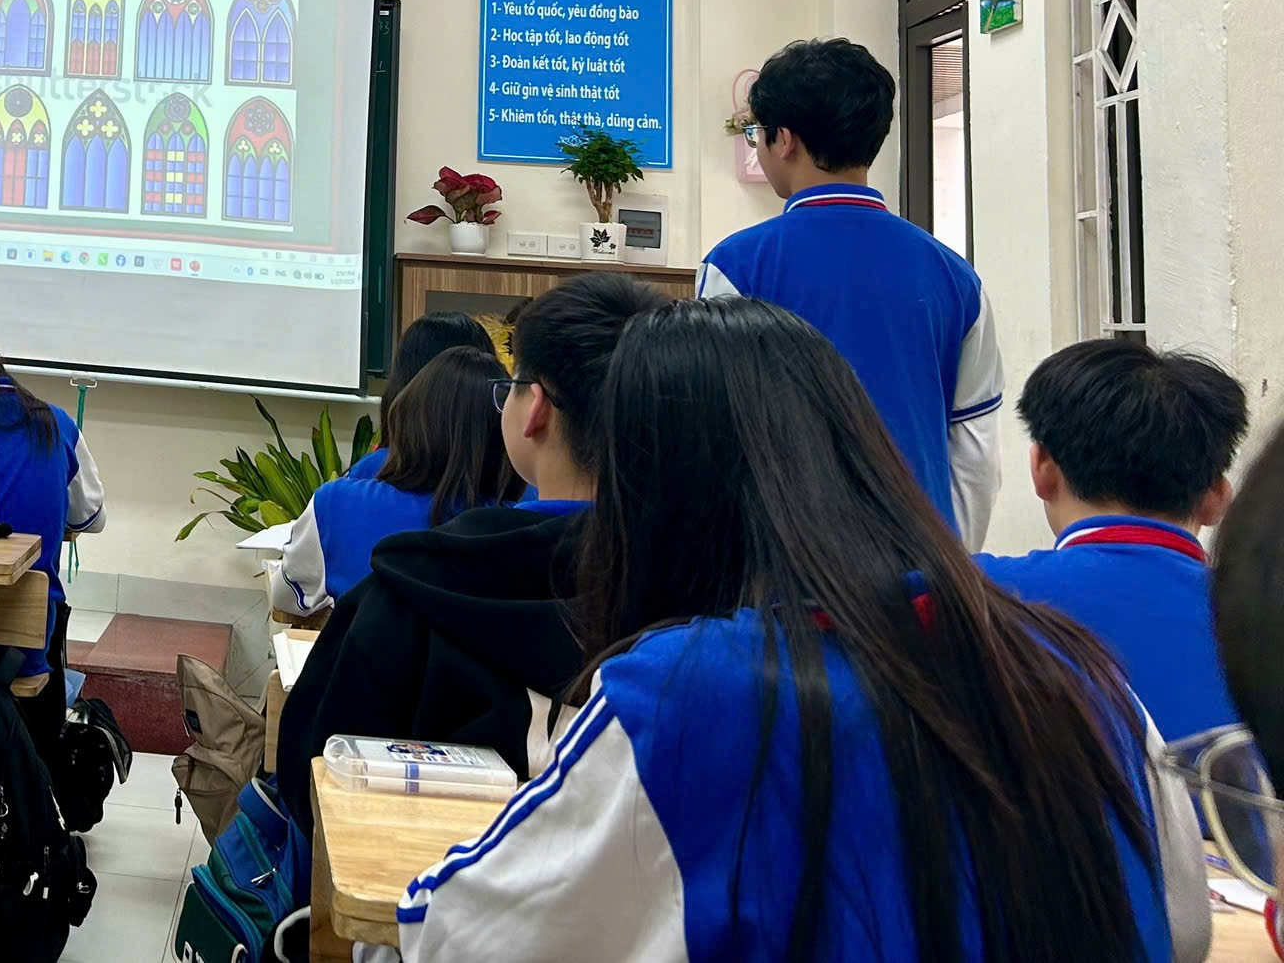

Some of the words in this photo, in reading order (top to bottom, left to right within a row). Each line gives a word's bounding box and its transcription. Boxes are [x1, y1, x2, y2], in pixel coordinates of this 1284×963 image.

[503, 2, 522, 16] Yêu
[524, 0, 535, 17] tổ
[537, 1, 566, 20] quốc,
[568, 4, 587, 21] yêu
[589, 2, 617, 22] đồng
[619, 5, 639, 20] bào
[503, 28, 523, 46] Học
[525, 28, 543, 48] tập
[545, 27, 563, 46] tốt,
[565, 30, 581, 45] lao
[583, 30, 611, 49] động
[613, 30, 630, 47] tốt
[502, 54, 530, 70] Đoàn
[532, 53, 550, 71] kết
[551, 54, 570, 73] tốt,
[572, 56, 585, 75] kỷ
[586, 57, 608, 76] luật
[609, 56, 626, 73] tốt
[501, 81, 521, 96] Giữ
[522, 82, 539, 100] gìn
[541, 85, 554, 101] vệ
[555, 84, 578, 98] sinh
[580, 84, 602, 103] thật
[604, 83, 620, 100] tốt
[501, 108, 535, 124] Khiêm
[537, 108, 557, 126] tốn,
[559, 110, 581, 129] thật
[583, 111, 605, 128] thà,
[606, 113, 634, 131] dũng
[636, 113, 662, 130] cảm.
